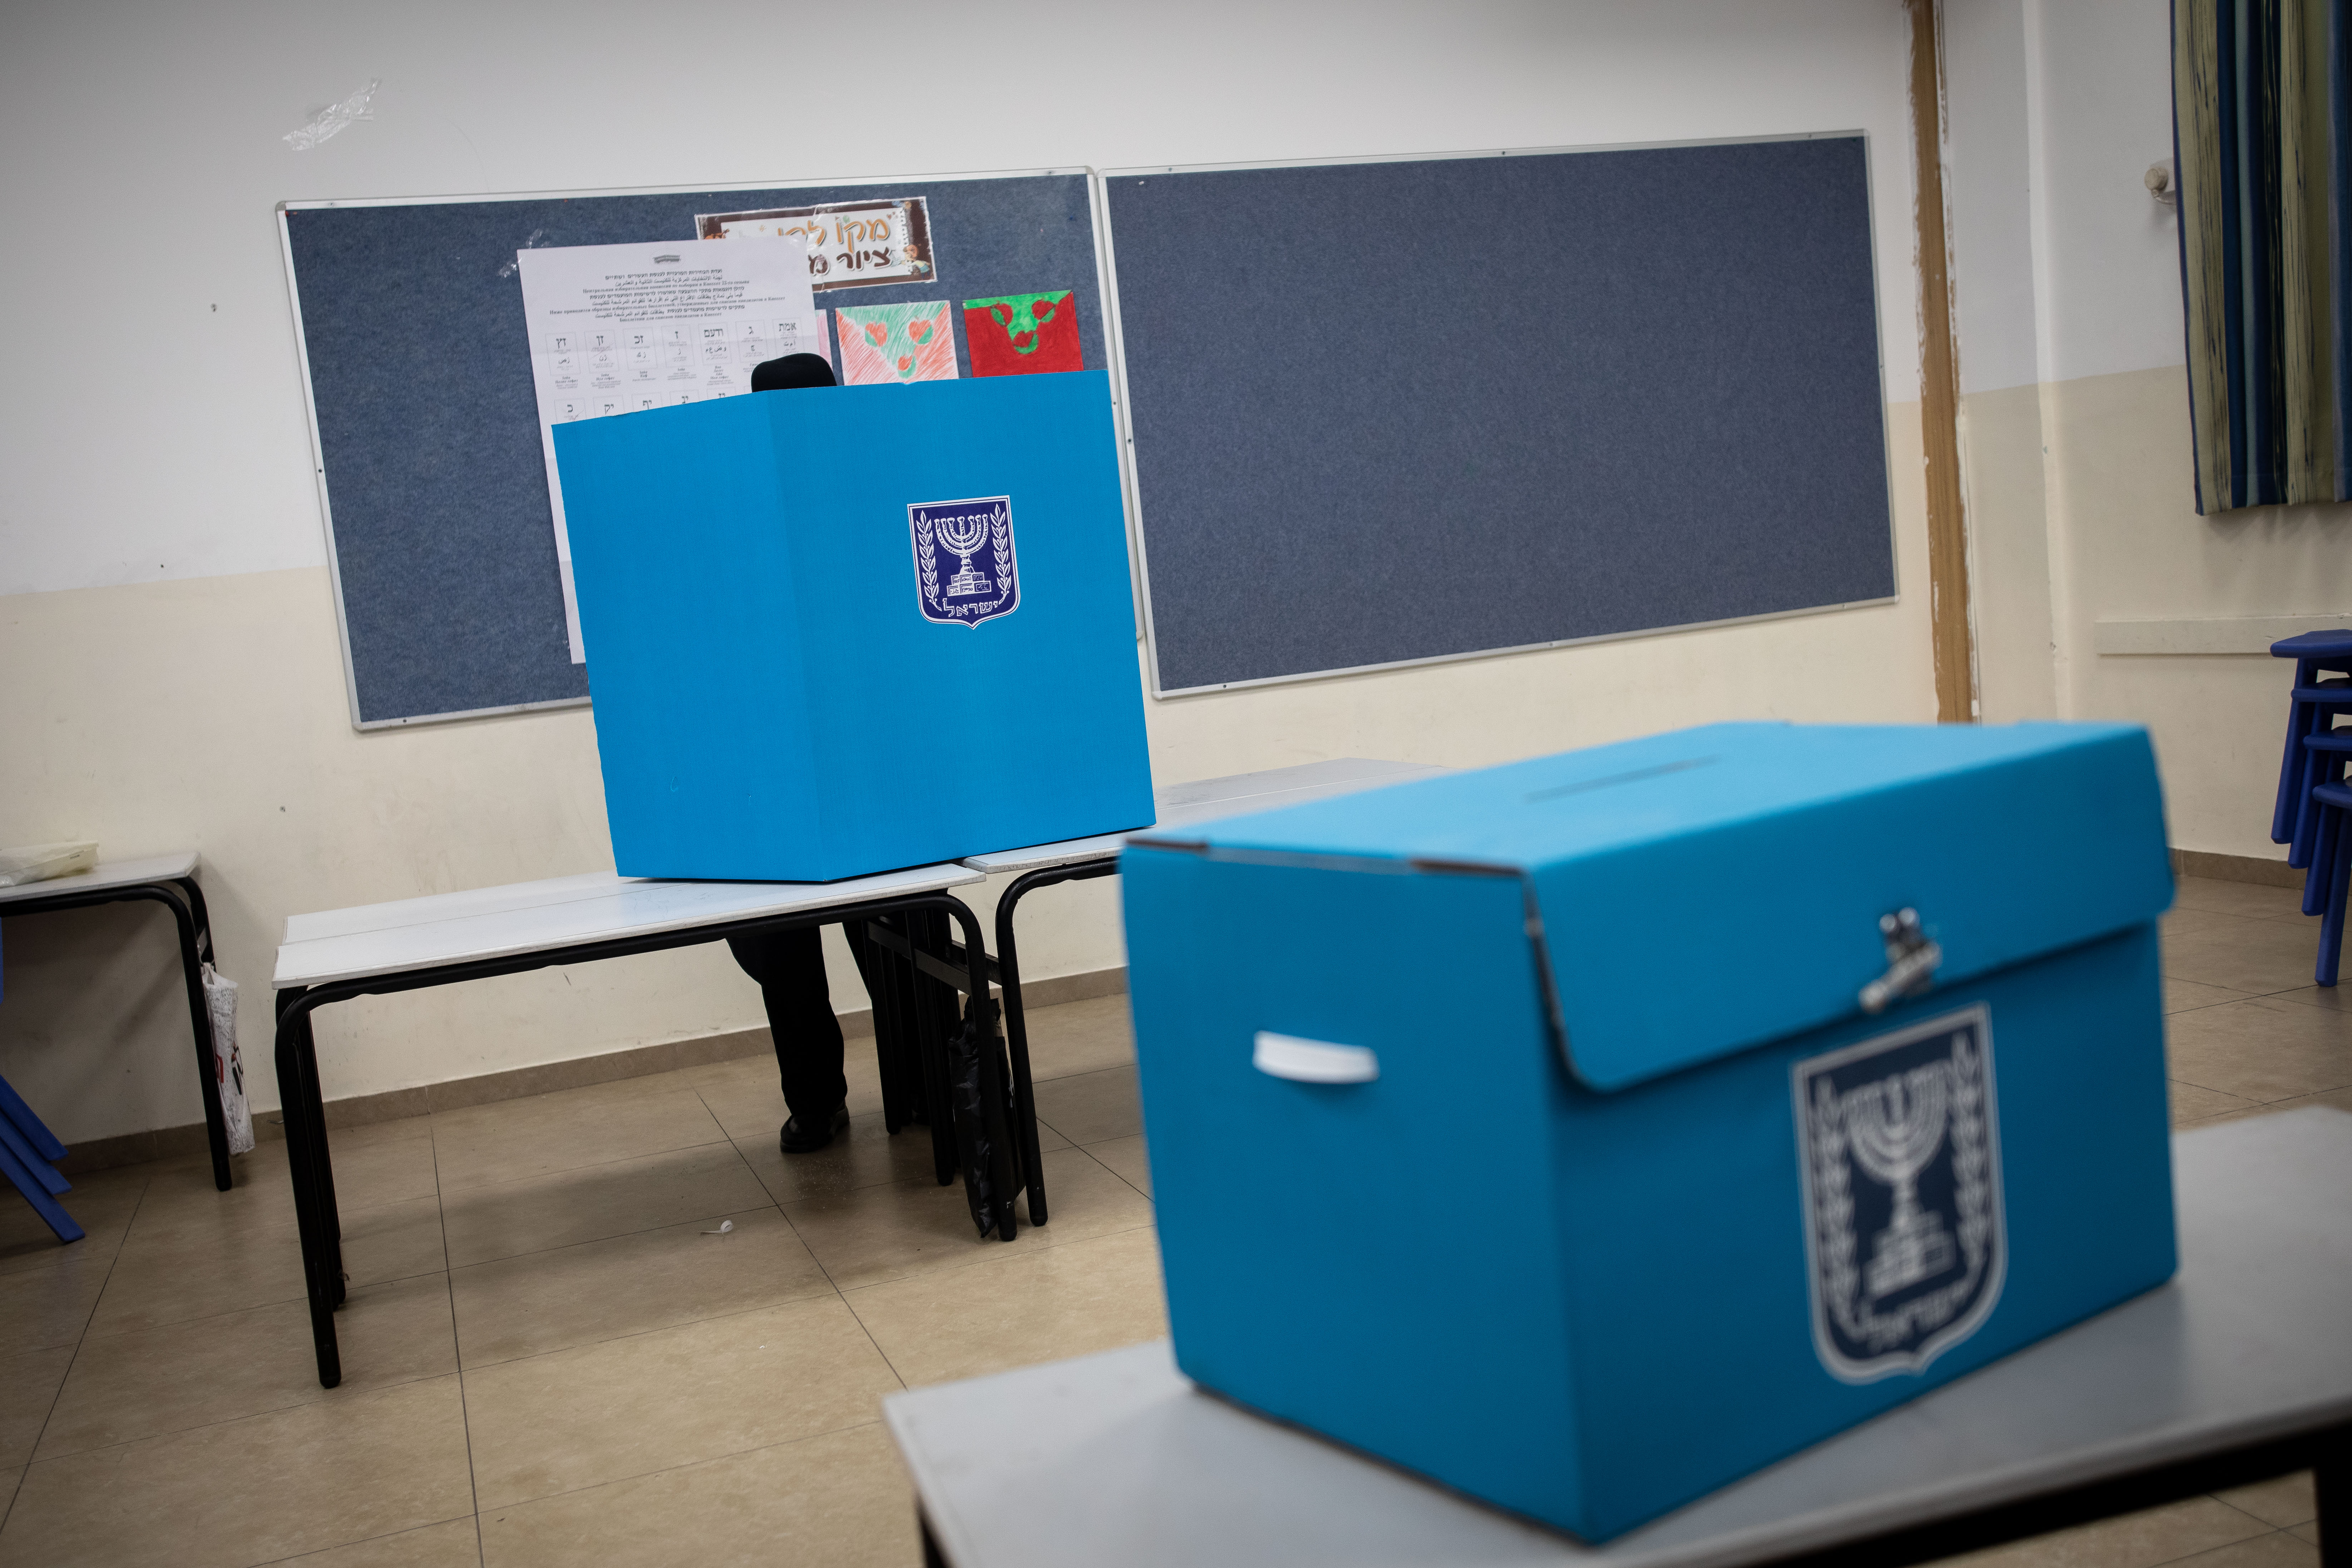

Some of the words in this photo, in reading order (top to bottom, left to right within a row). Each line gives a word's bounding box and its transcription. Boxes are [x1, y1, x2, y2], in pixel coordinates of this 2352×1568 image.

[837, 247, 891, 270] ציור
[749, 326, 754, 335] ג
[779, 322, 797, 332] אמת
[675, 331, 679, 339] ז
[704, 328, 724, 337] ודעם
[556, 337, 566, 349] זץ
[634, 335, 644, 344] זכ
[942, 598, 998, 617] ישראל
